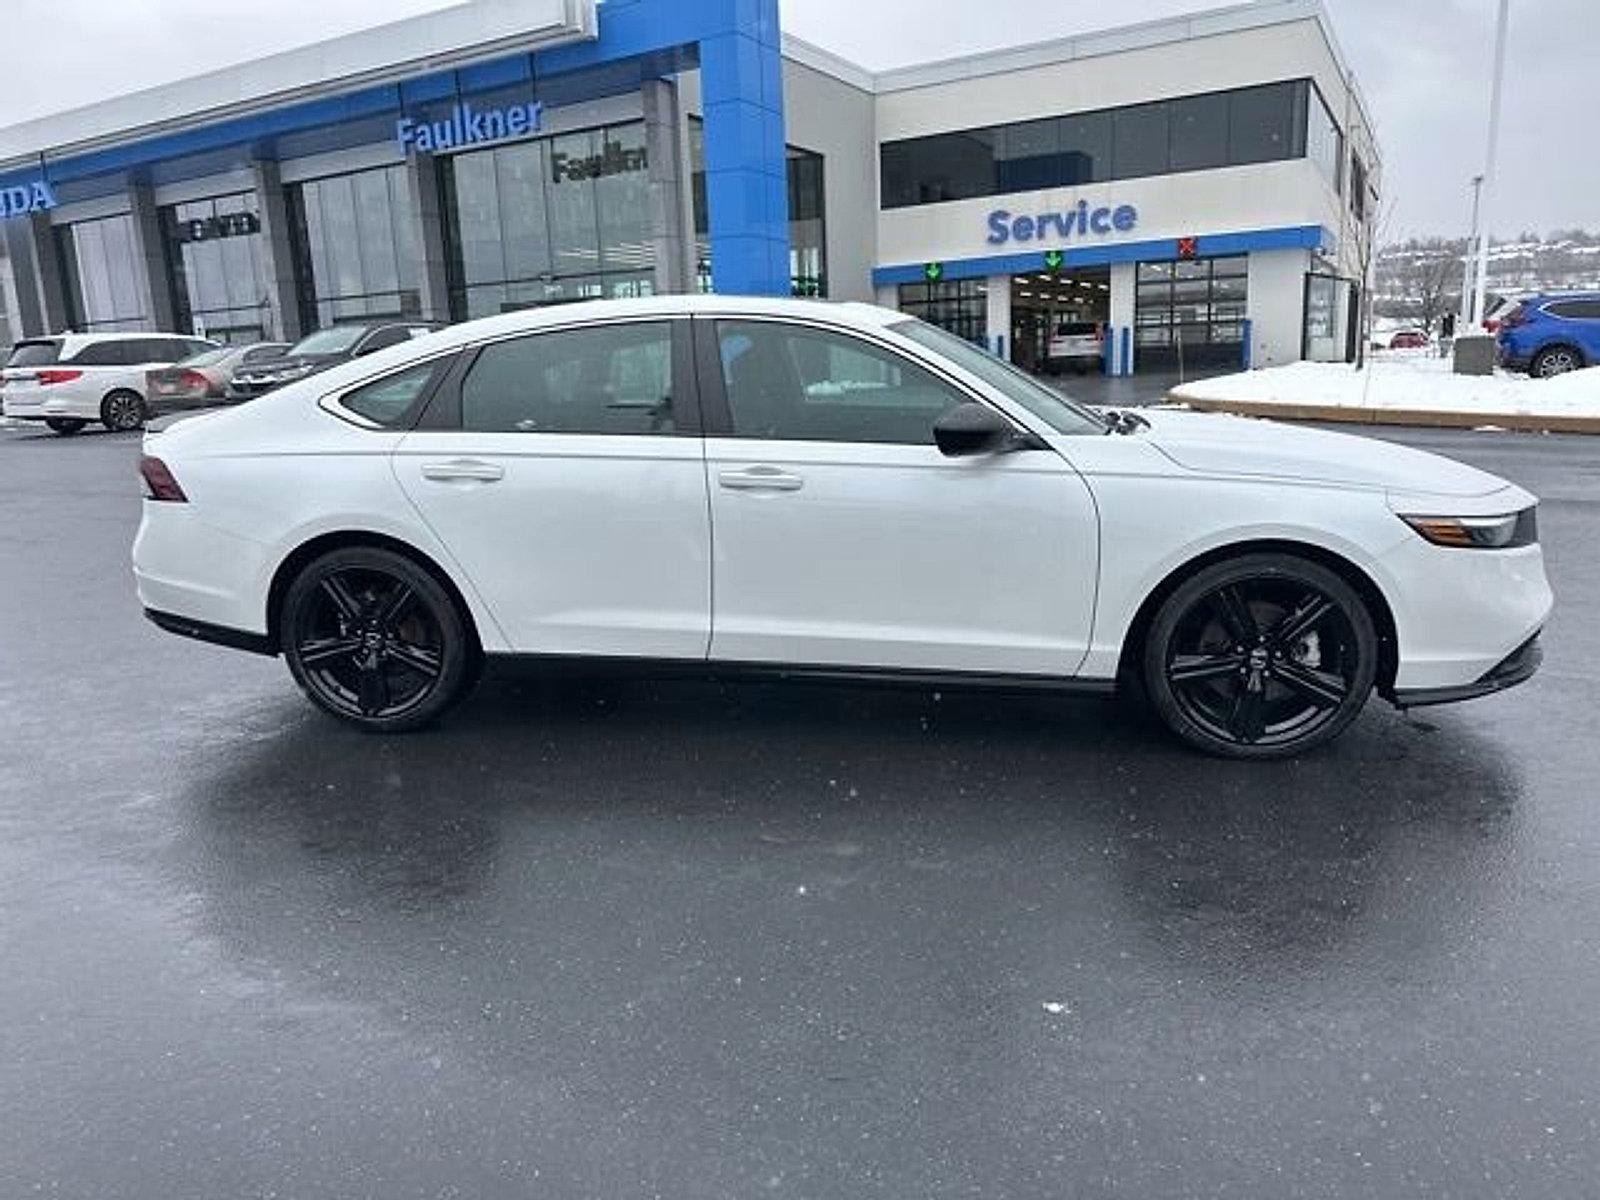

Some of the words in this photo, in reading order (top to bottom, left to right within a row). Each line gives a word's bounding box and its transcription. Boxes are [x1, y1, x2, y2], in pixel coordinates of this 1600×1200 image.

[396, 100, 543, 157] Faulkner
[0, 181, 57, 216] DA
[987, 199, 1138, 245] Service
